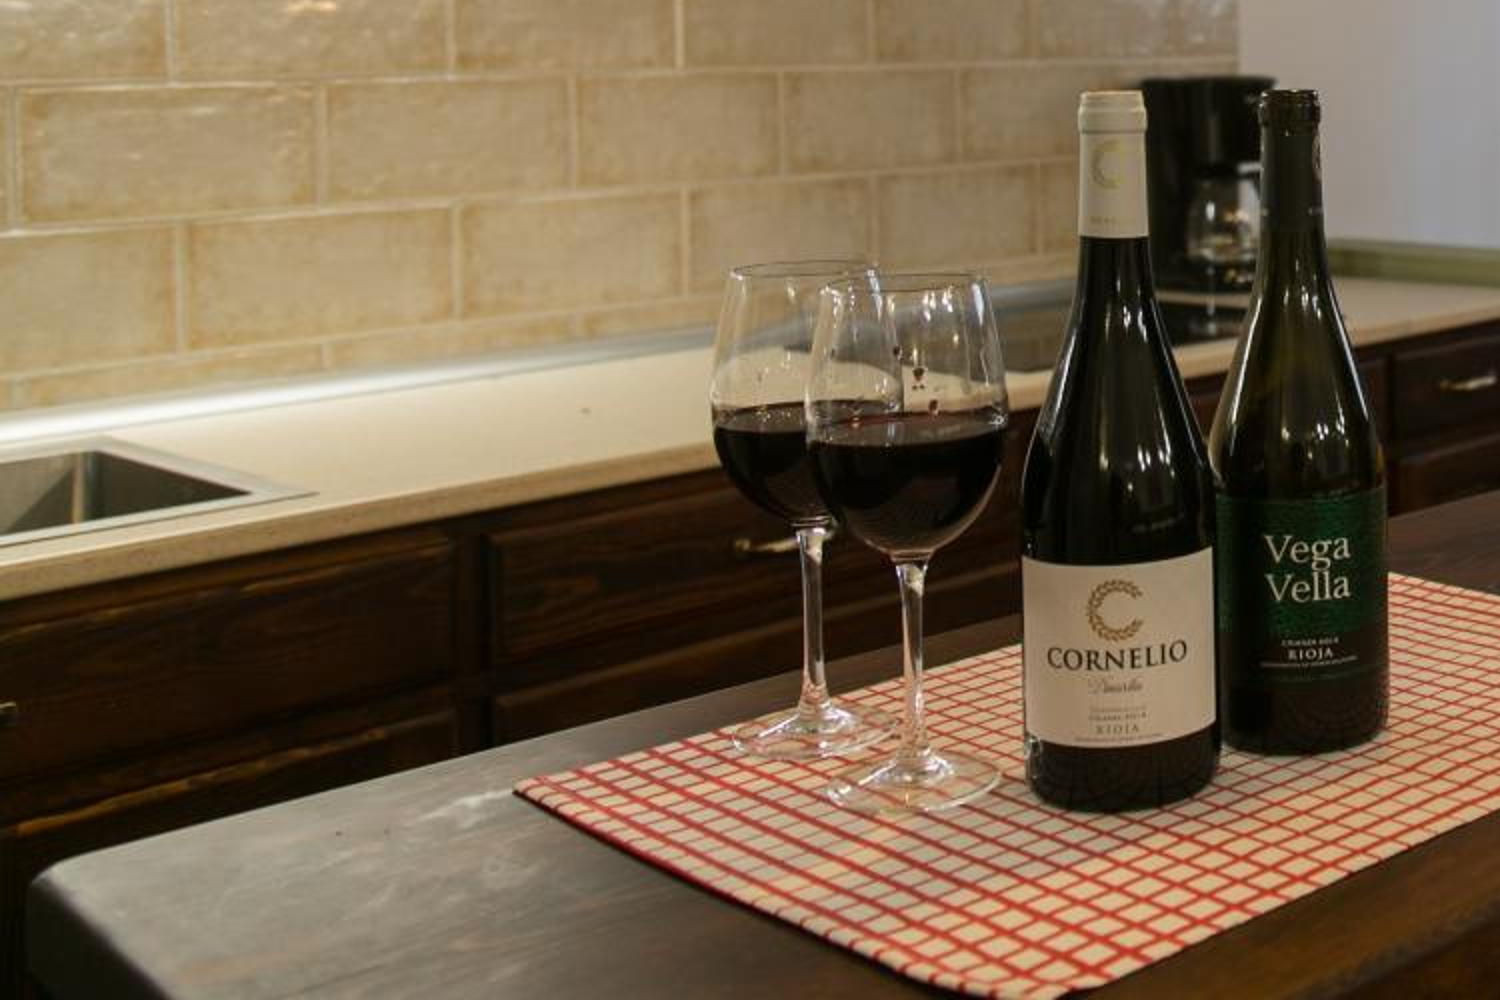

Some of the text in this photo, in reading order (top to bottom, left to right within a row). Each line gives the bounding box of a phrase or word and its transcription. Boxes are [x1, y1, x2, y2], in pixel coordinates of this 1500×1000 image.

[1264, 534, 1351, 572] Vega
[1265, 571, 1351, 603] Vella
[1047, 639, 1188, 672] CORNELIO
